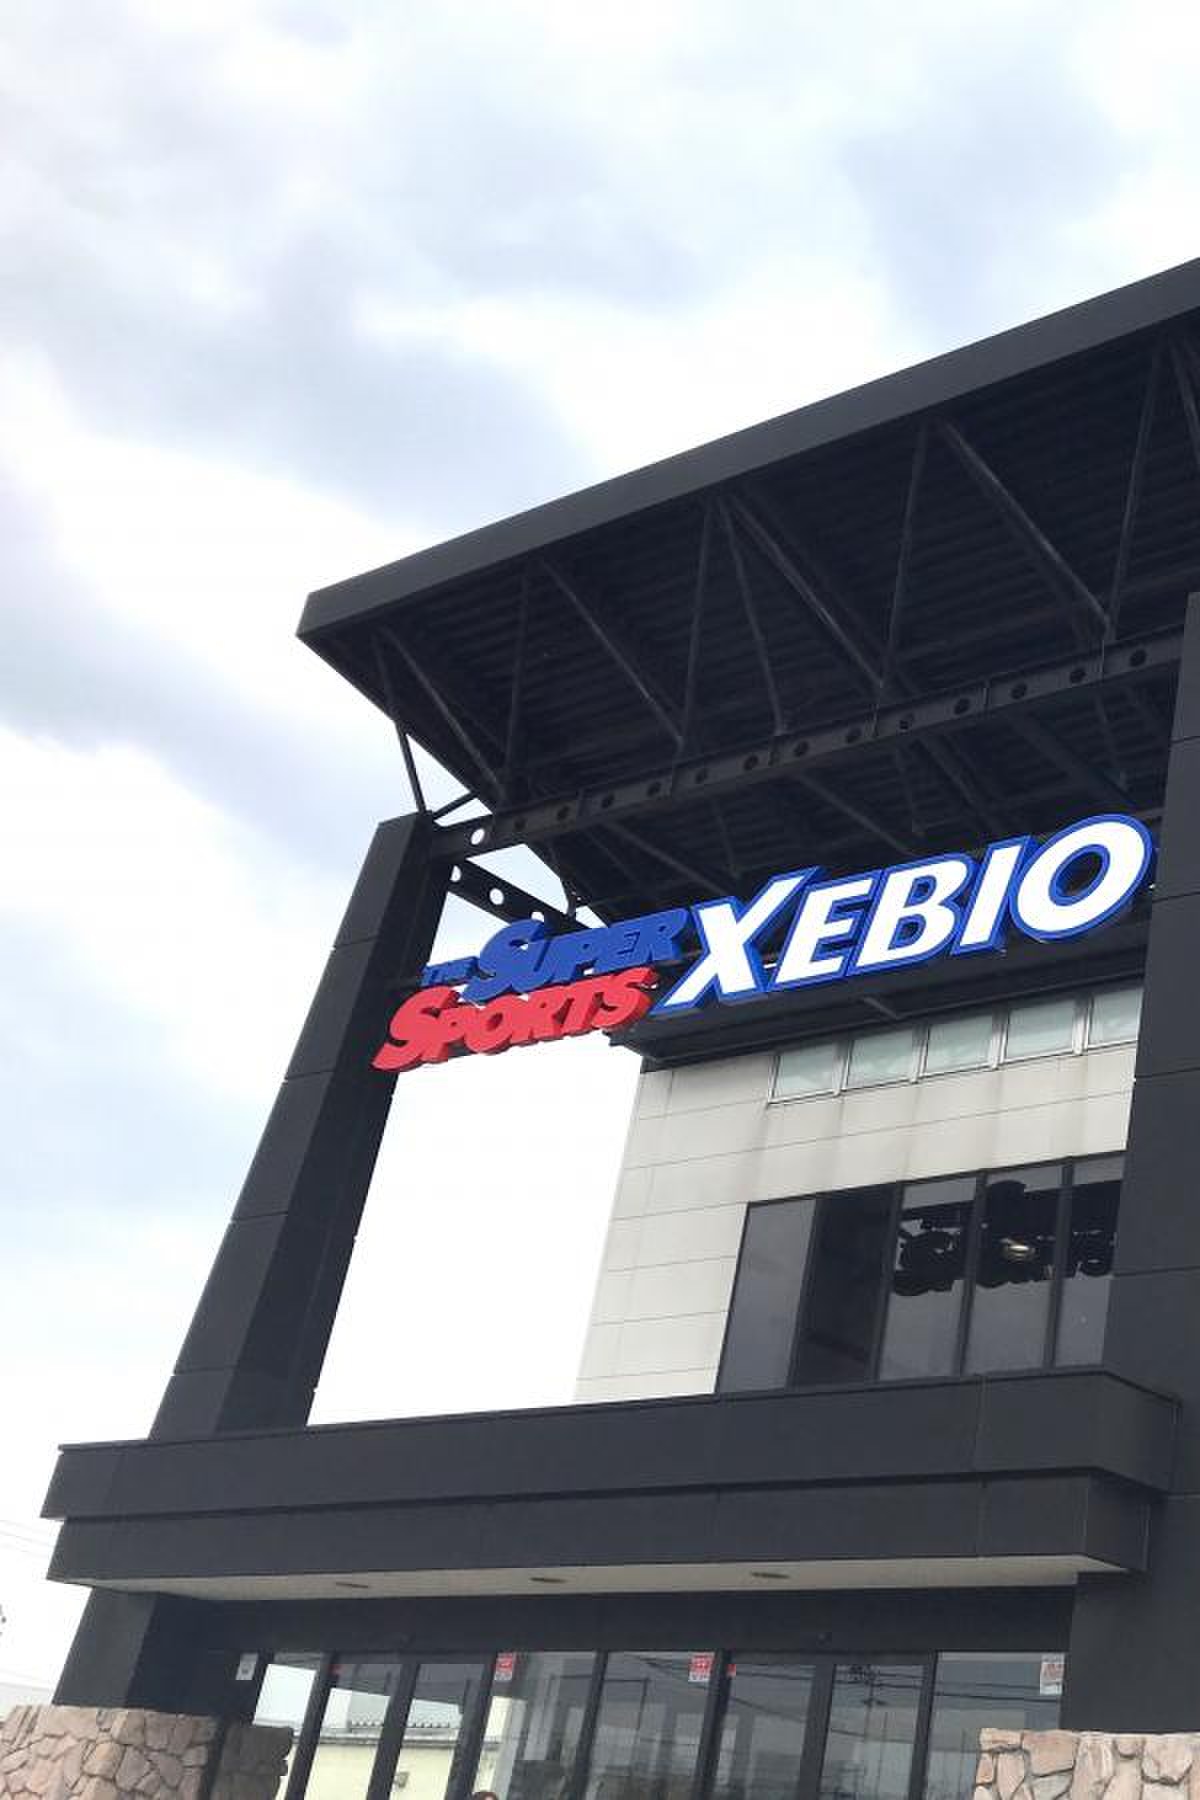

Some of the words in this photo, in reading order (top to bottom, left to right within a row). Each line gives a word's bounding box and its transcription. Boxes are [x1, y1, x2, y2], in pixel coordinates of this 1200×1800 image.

[461, 918, 690, 1004] SUPER
[652, 815, 1152, 1015] XEBIO
[372, 966, 657, 1071] SPORTS
